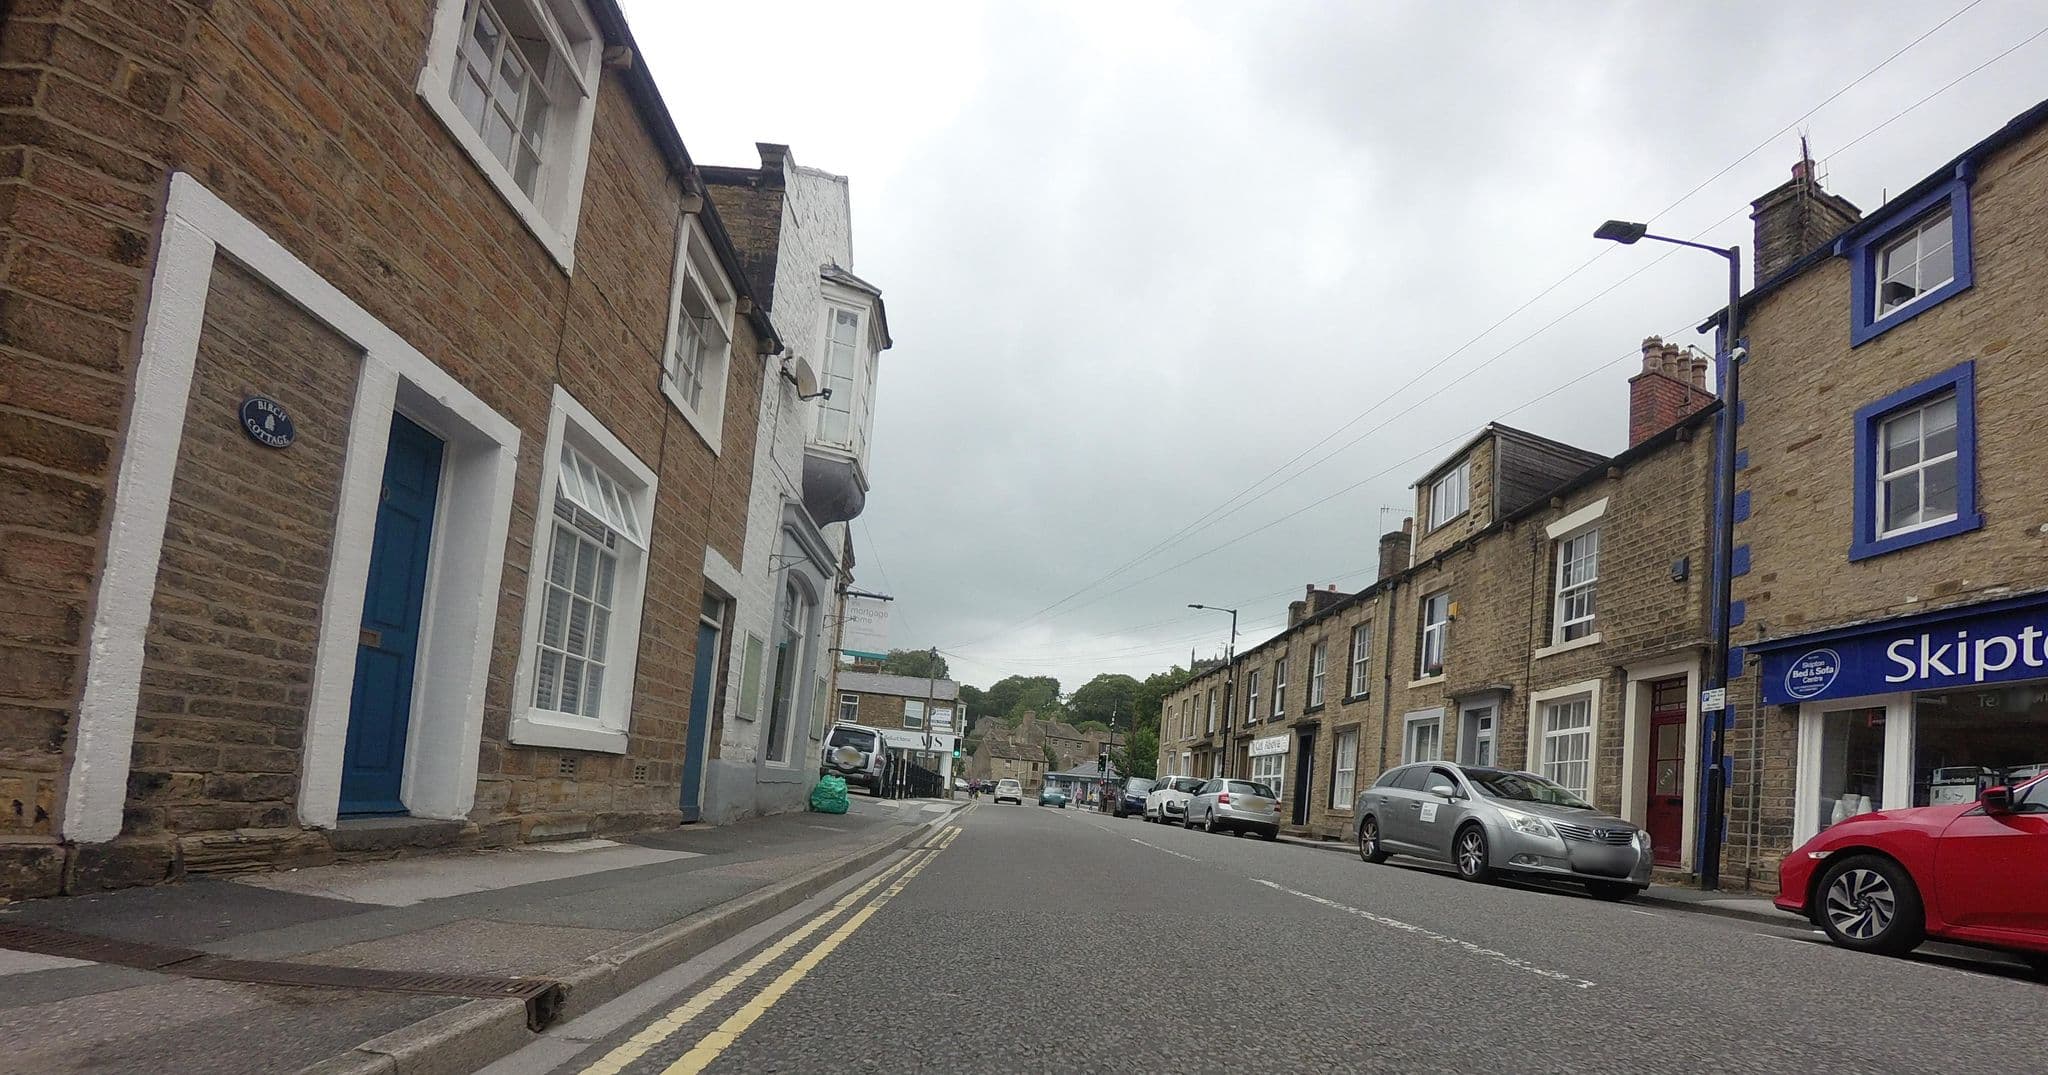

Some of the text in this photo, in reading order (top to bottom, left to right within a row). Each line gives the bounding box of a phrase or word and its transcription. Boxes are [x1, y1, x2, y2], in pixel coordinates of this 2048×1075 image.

[257, 400, 287, 422] BIRCH
[247, 418, 289, 445] COTTAGE
[1885, 625, 2048, 683] Skipt
[1792, 669, 1808, 678] Bed
[1815, 666, 1834, 675] Sofa
